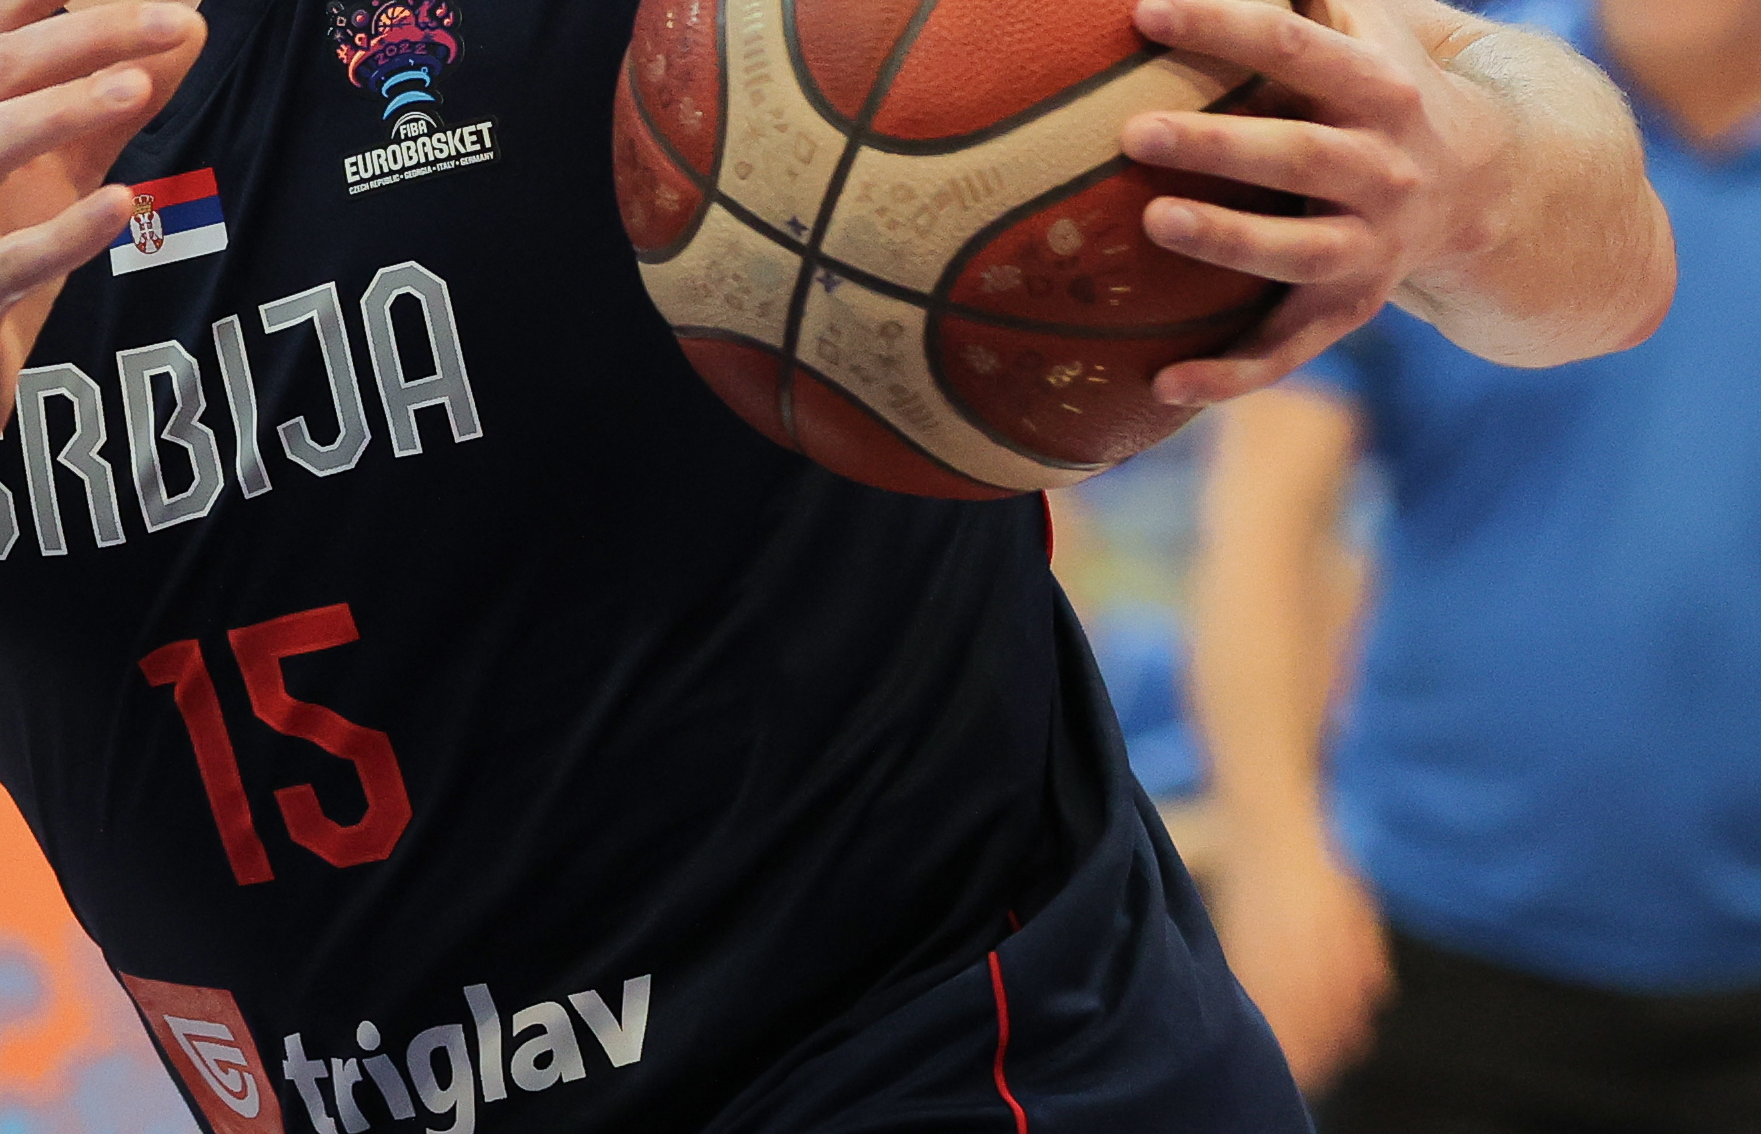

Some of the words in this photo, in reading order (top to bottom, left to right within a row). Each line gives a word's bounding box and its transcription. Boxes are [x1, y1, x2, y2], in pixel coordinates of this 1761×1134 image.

[375, 43, 428, 65] 2022
[344, 122, 492, 183] EUROBASKET
[399, 121, 427, 140] FIBA
[349, 183, 369, 194] CZECH
[370, 174, 400, 188] REPUBLIC
[404, 166, 432, 179] GEORGIA
[437, 160, 455, 171] ITALY
[460, 151, 494, 166] GERMANY
[137, 602, 414, 887] 15
[281, 972, 652, 1134] triglav
